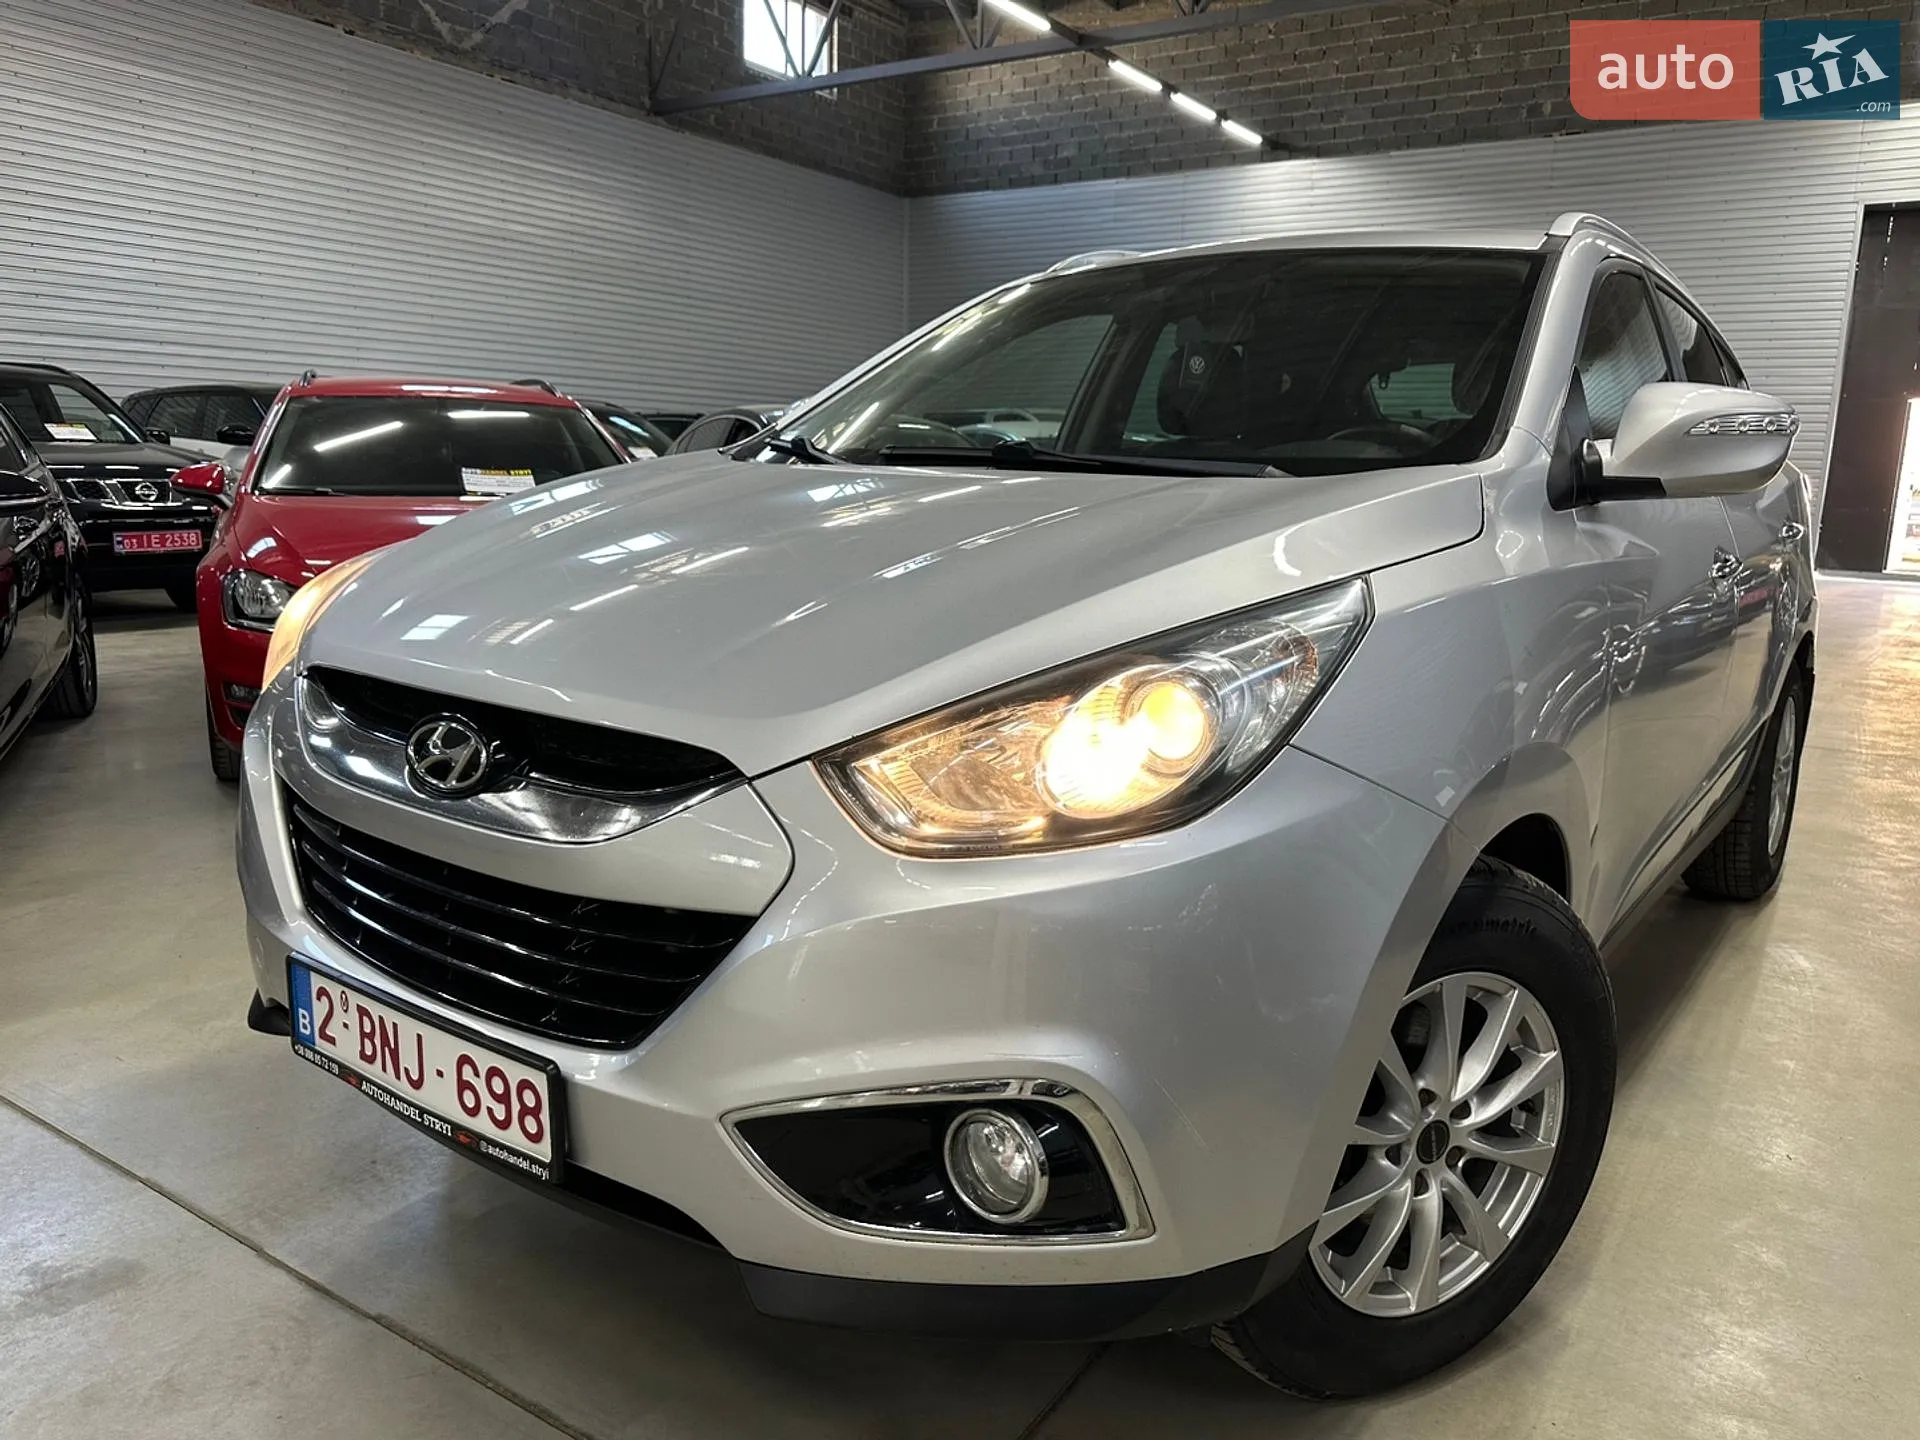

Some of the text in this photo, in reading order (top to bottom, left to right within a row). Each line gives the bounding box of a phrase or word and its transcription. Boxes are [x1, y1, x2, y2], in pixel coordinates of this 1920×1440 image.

[123, 532, 197, 549] 03 IE 2538
[298, 1007, 311, 1035] B
[361, 1080, 452, 1136] AUTOHANDEL STRYI
